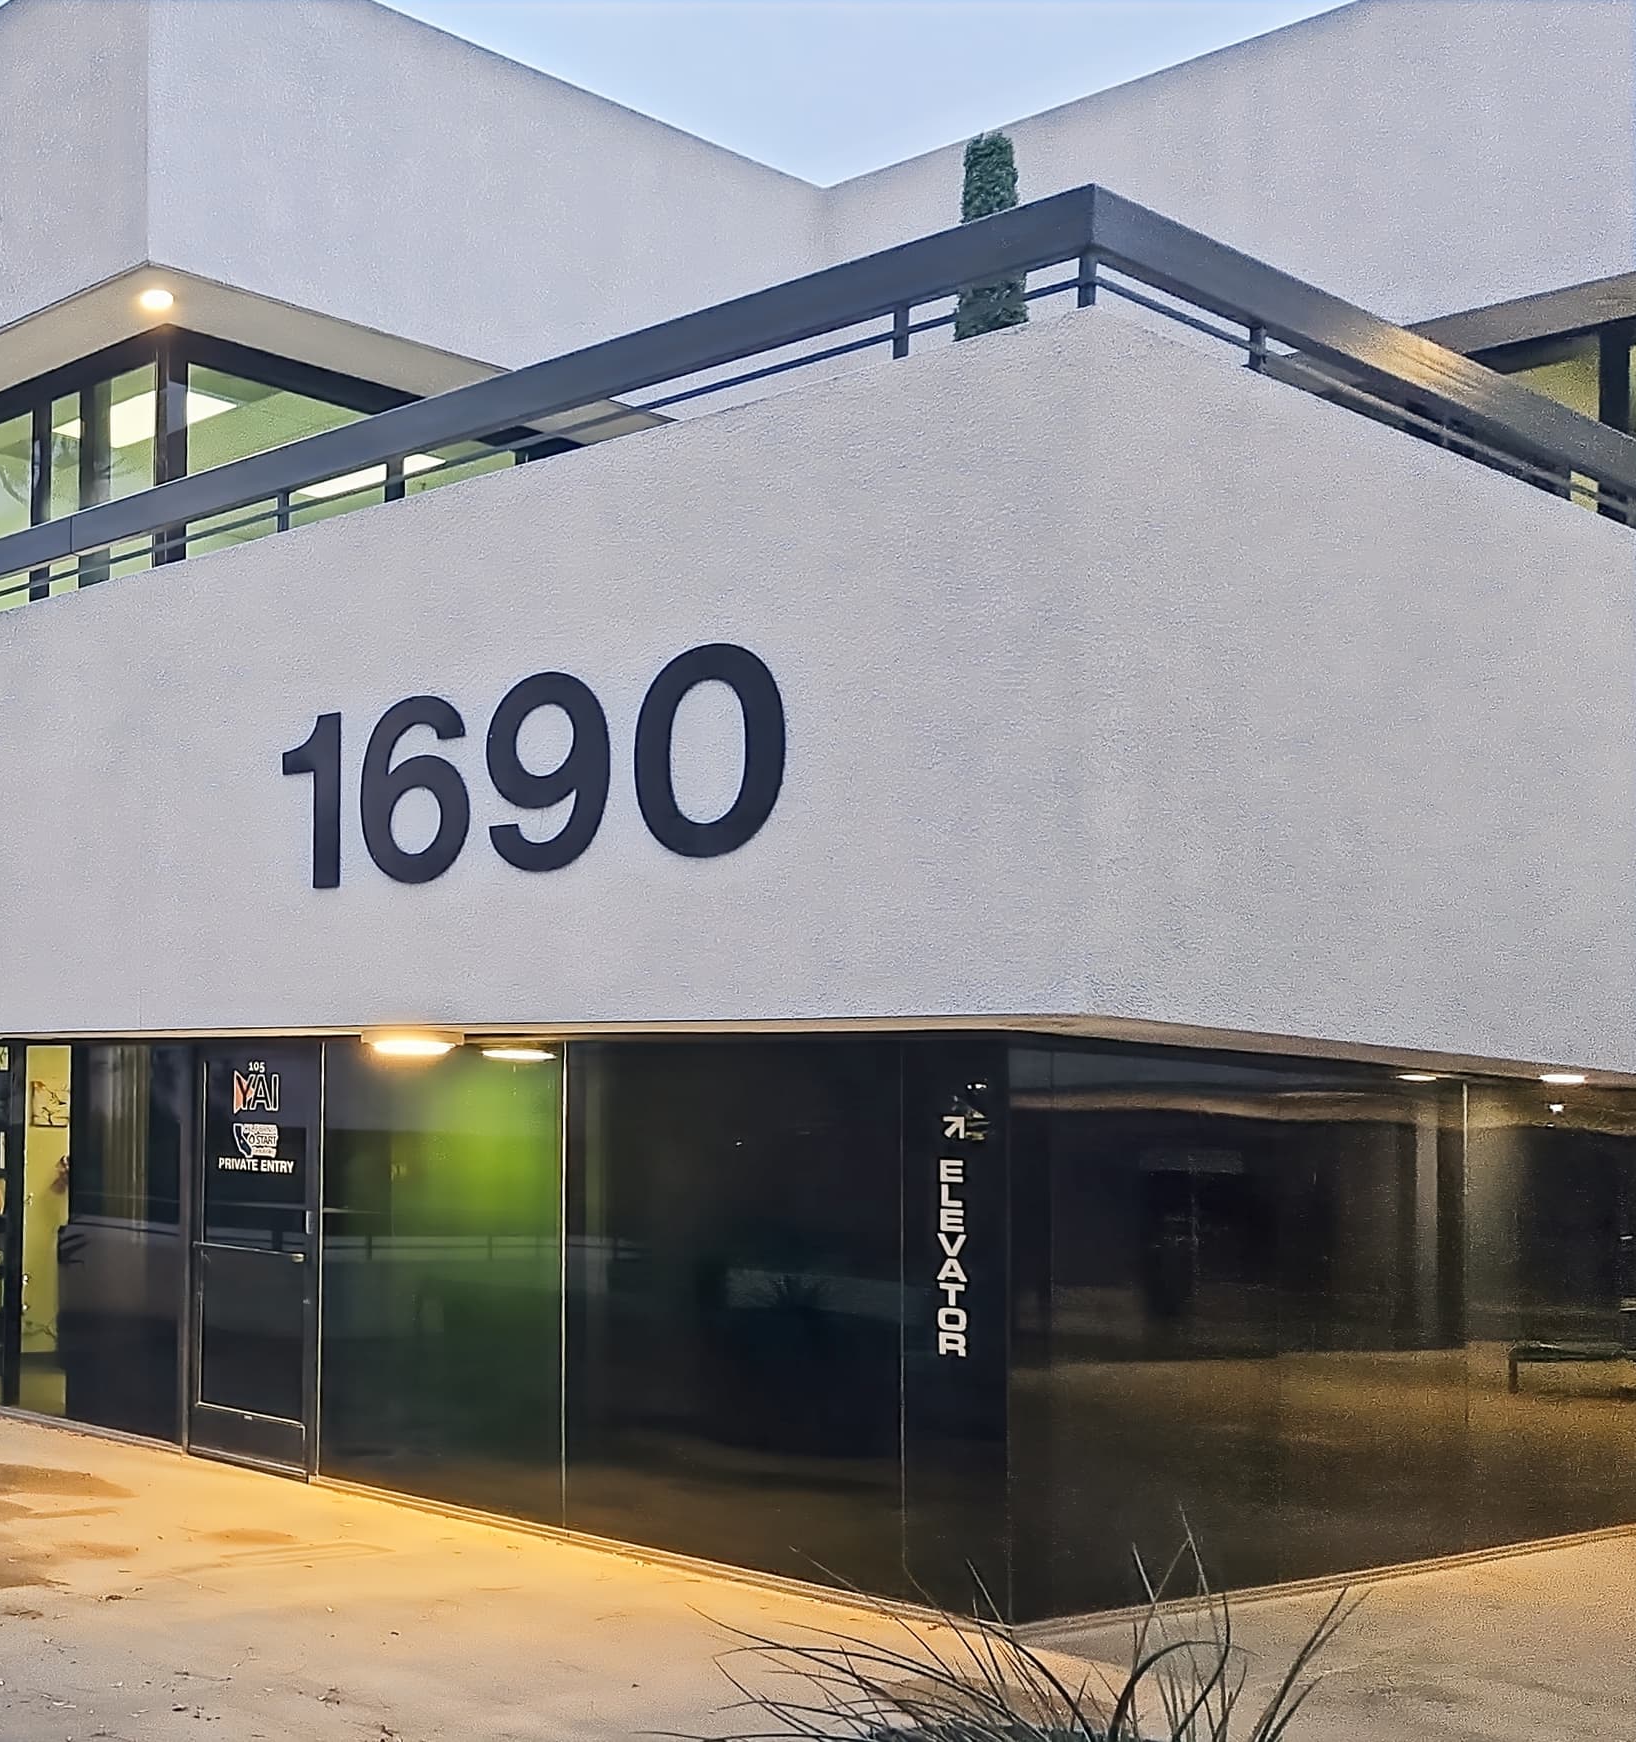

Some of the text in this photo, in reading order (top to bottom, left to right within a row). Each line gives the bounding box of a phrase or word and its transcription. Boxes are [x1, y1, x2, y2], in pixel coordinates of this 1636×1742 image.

[282, 642, 786, 889] 1690
[248, 1061, 265, 1073] 105
[234, 1071, 279, 1113] YAI
[218, 1157, 294, 1173] PRIVATE ENTRY
[937, 1159, 967, 1357] ELEVATOR
